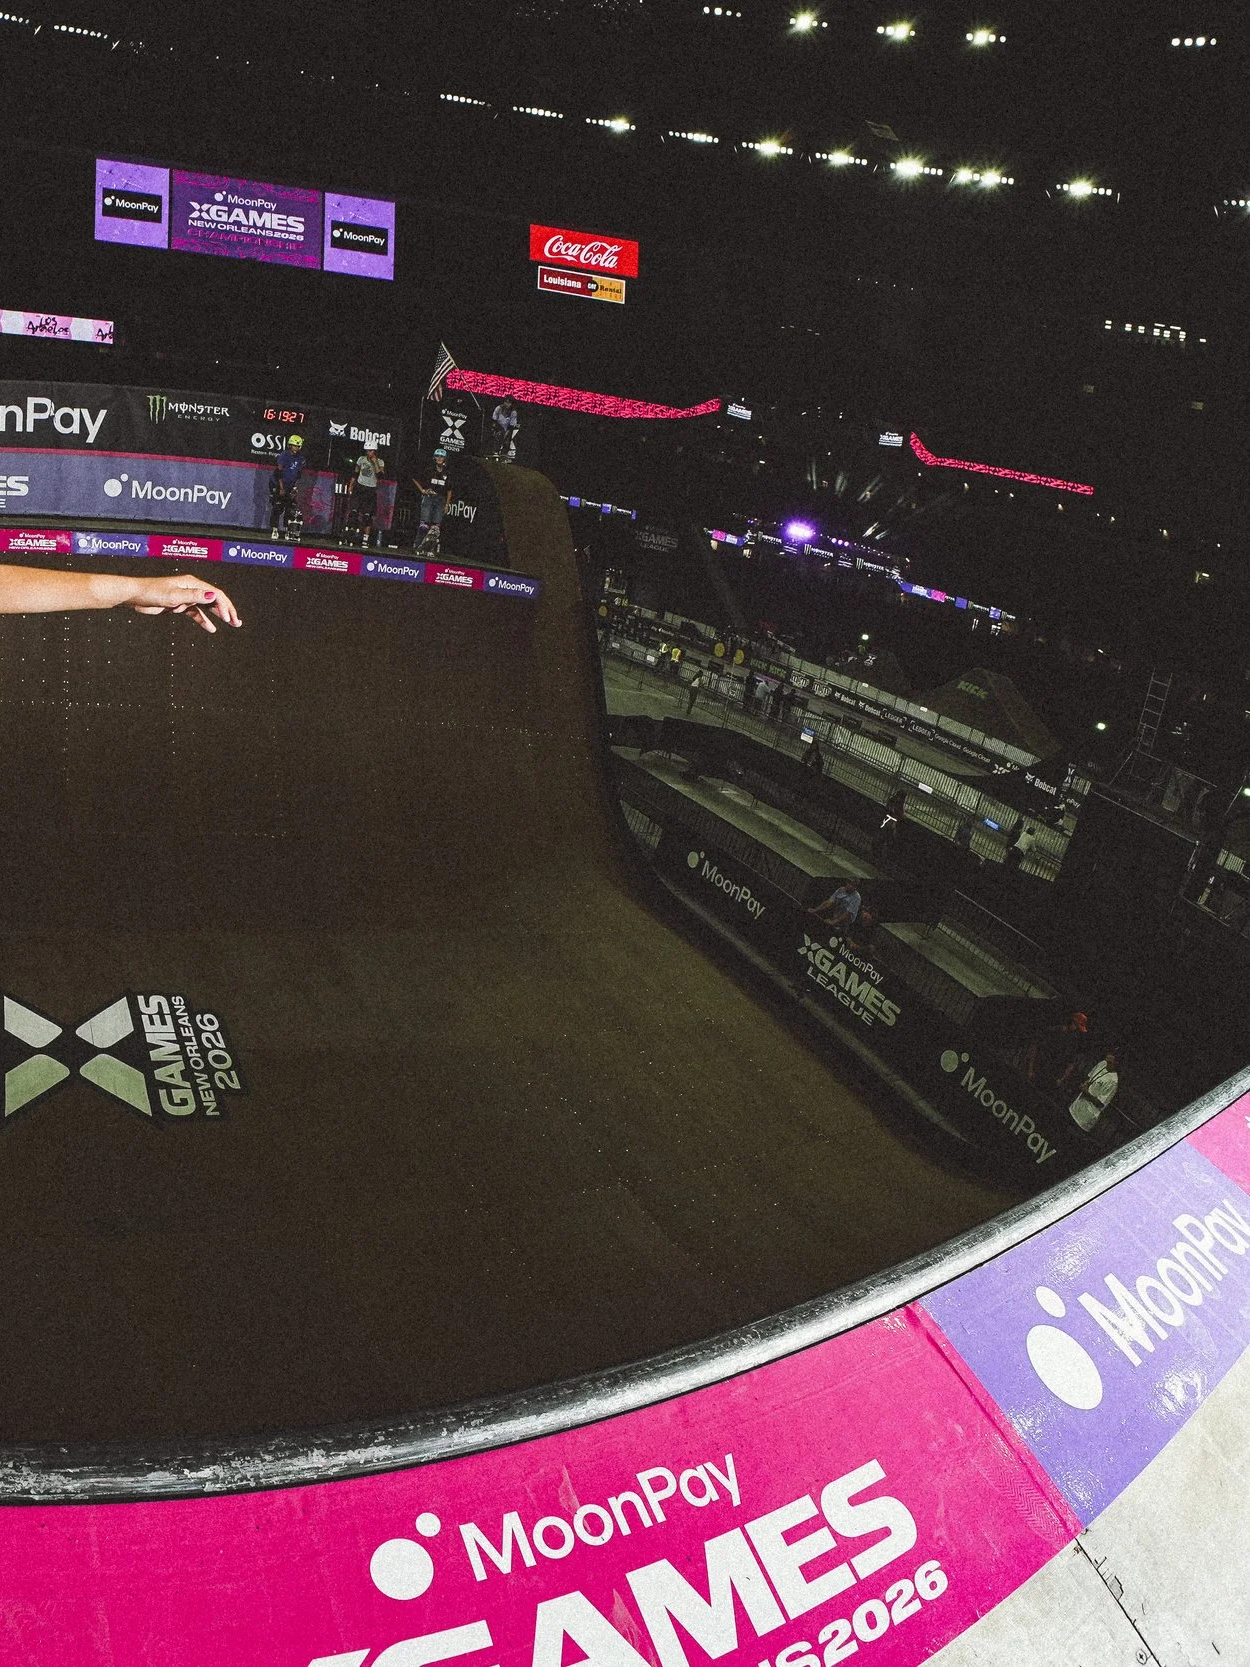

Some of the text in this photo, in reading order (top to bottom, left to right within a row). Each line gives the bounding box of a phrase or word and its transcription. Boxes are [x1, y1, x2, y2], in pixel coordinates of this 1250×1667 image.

[116, 198, 159, 214] MoonPay
[228, 194, 277, 212] MoonPay
[189, 201, 305, 233] XGAMES
[344, 230, 386, 246] MoonPay
[544, 235, 623, 268] Coca-Cola
[544, 274, 582, 289] Louisiana
[168, 402, 230, 417] MONSTER
[350, 426, 391, 446] Bobcat
[440, 435, 465, 446] GAMES
[132, 480, 232, 510] MoonPay
[8, 539, 57, 547] XGAMES
[91, 539, 142, 552] MoonPay
[162, 545, 209, 555] XGAMES
[241, 548, 288, 563] MoonPay
[307, 557, 349, 569] XGAMES
[378, 563, 420, 578] MoonPay
[498, 579, 535, 595] MoonPay
[1034, 778, 1057, 796] Bobcat
[702, 860, 767, 920] MoonPay
[839, 943, 883, 986] MoonPay
[796, 933, 902, 1028] XGAMES
[807, 966, 874, 1027] LEAGUE
[137, 994, 197, 1116] GAMES
[195, 1013, 241, 1090] 2026
[960, 1066, 1058, 1164] MoonPay
[458, 1453, 743, 1582] MoonPay
[308, 1458, 919, 1667] AMES
